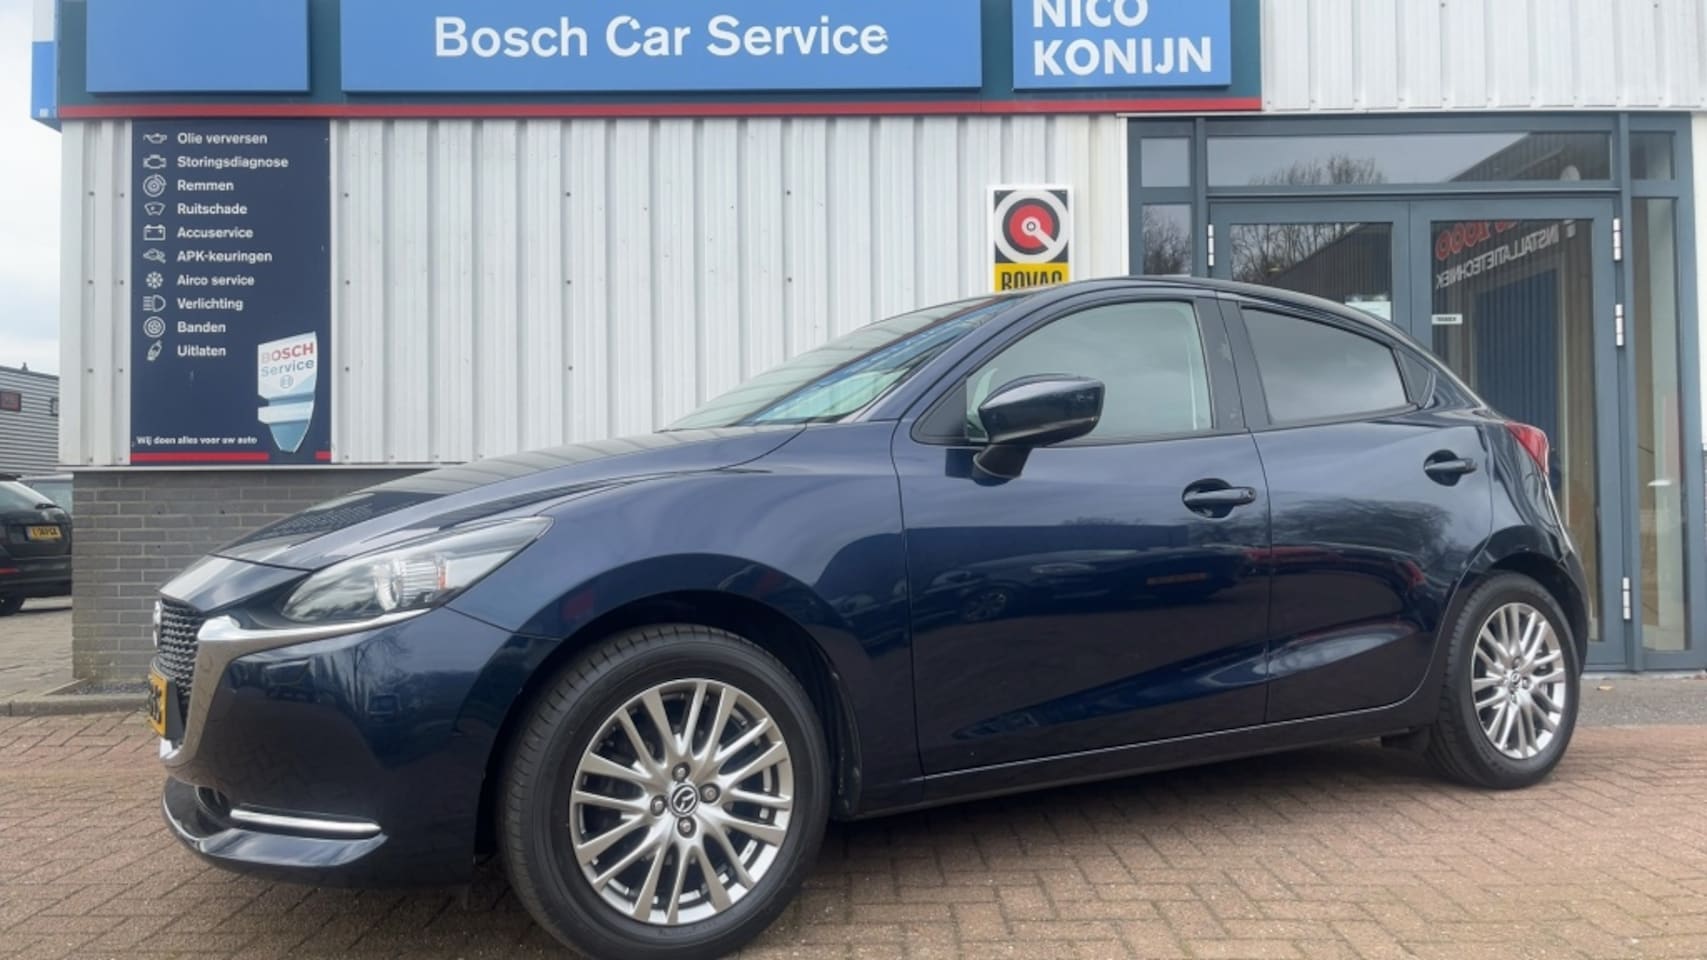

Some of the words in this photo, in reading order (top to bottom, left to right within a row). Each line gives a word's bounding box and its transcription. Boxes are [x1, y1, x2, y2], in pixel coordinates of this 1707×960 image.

[1032, 0, 1149, 28] NICO
[434, 16, 588, 58] Bosch
[605, 15, 691, 58] Car
[706, 14, 889, 57] Service
[1033, 36, 1212, 77] KONIJN
[177, 132, 203, 145] Olie
[206, 133, 268, 145] verversen
[177, 155, 289, 170] Storingsdiagnose
[177, 179, 235, 192] Remmen
[177, 202, 248, 215] Ruitschade
[177, 226, 254, 239] Accuservice
[177, 250, 273, 264] APK-keuringen
[177, 274, 208, 287] Airco
[211, 274, 255, 287] service
[177, 297, 243, 312] Verlichting
[177, 320, 226, 334] Banden
[177, 344, 226, 358] Uitlaten
[260, 342, 314, 365] BOSCH
[260, 358, 315, 377] Service
[136, 436, 152, 446] Wij
[153, 436, 176, 445] doen
[177, 436, 198, 445] alles
[200, 437, 220, 445] voor
[221, 437, 236, 445] uw
[237, 436, 258, 445] auto
